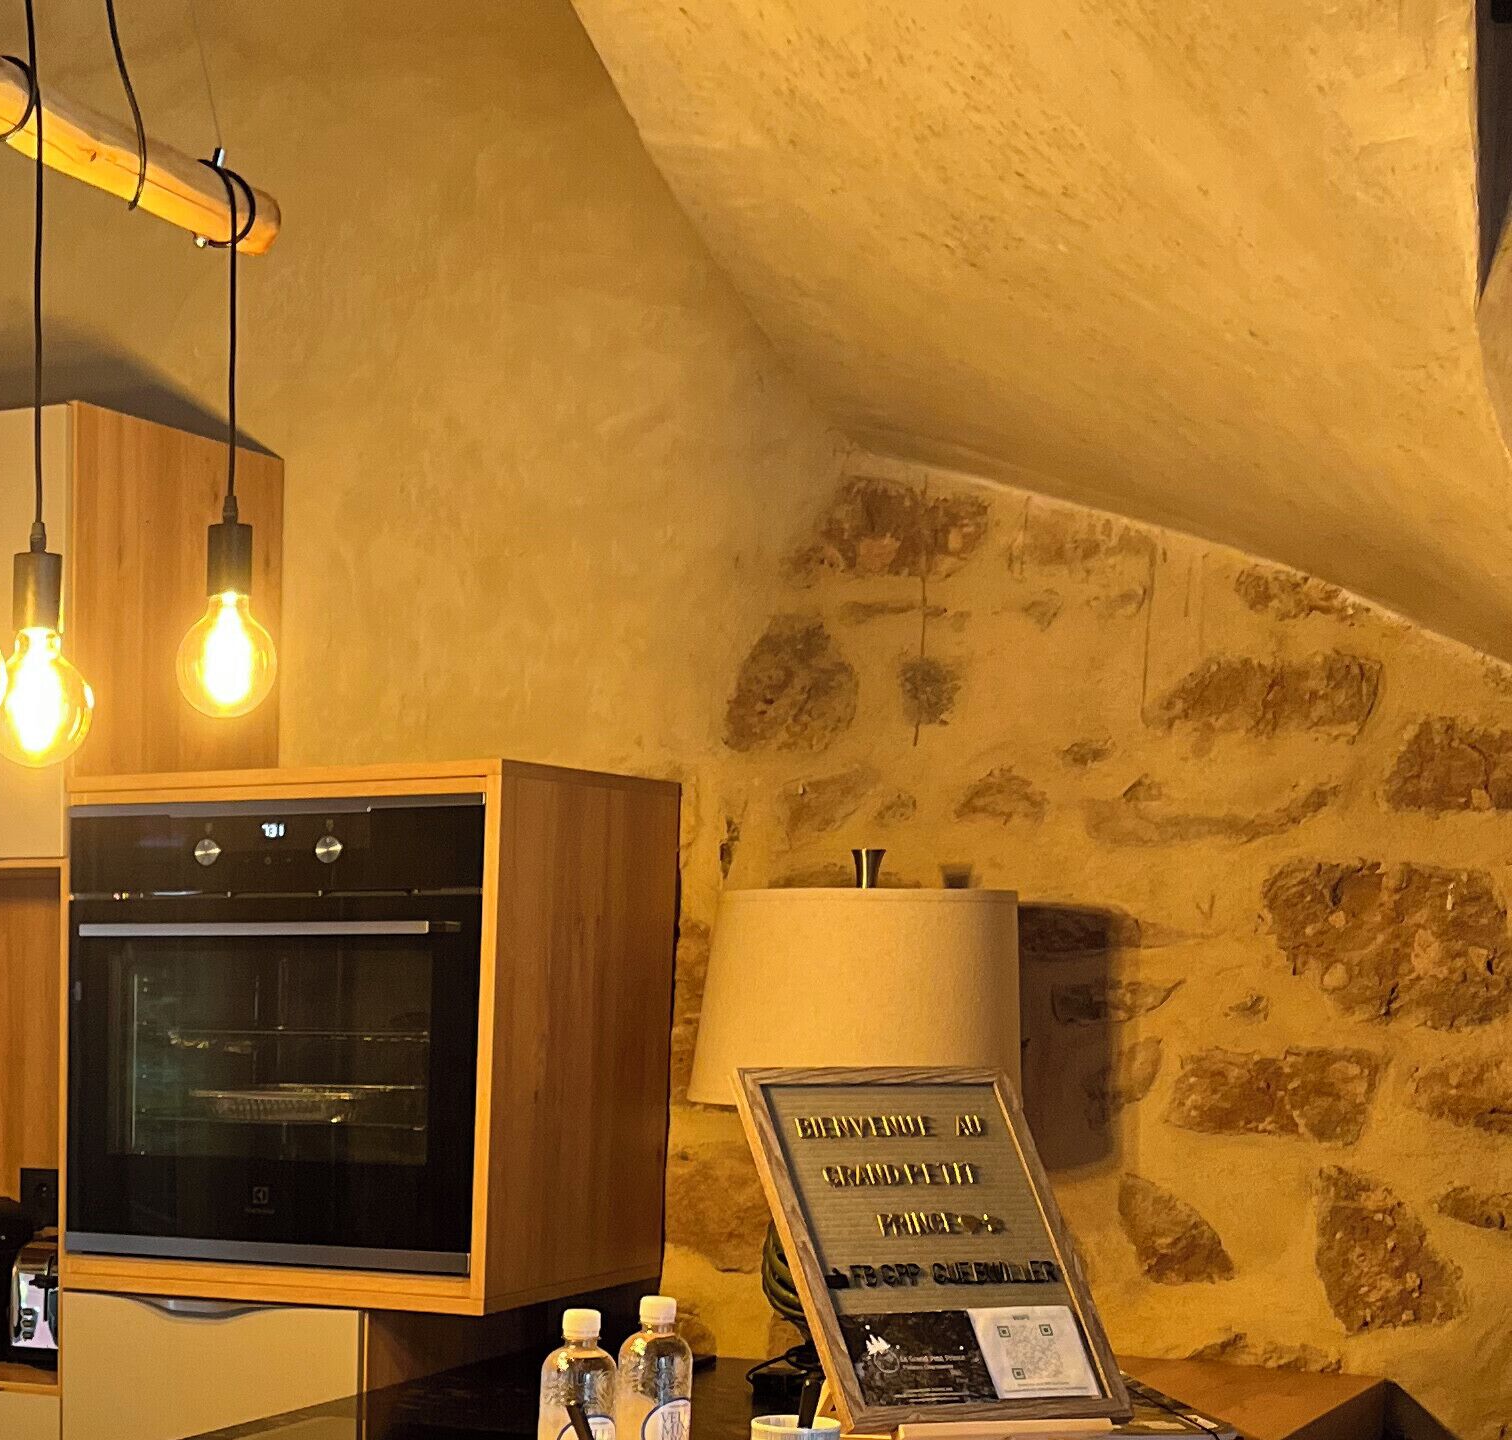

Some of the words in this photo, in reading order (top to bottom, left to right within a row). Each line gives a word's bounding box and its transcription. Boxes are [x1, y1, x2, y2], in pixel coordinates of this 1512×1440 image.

[794, 1115, 938, 1139] BIENVENUE
[954, 1114, 984, 1137] AU
[876, 1212, 958, 1237] PRINCE
